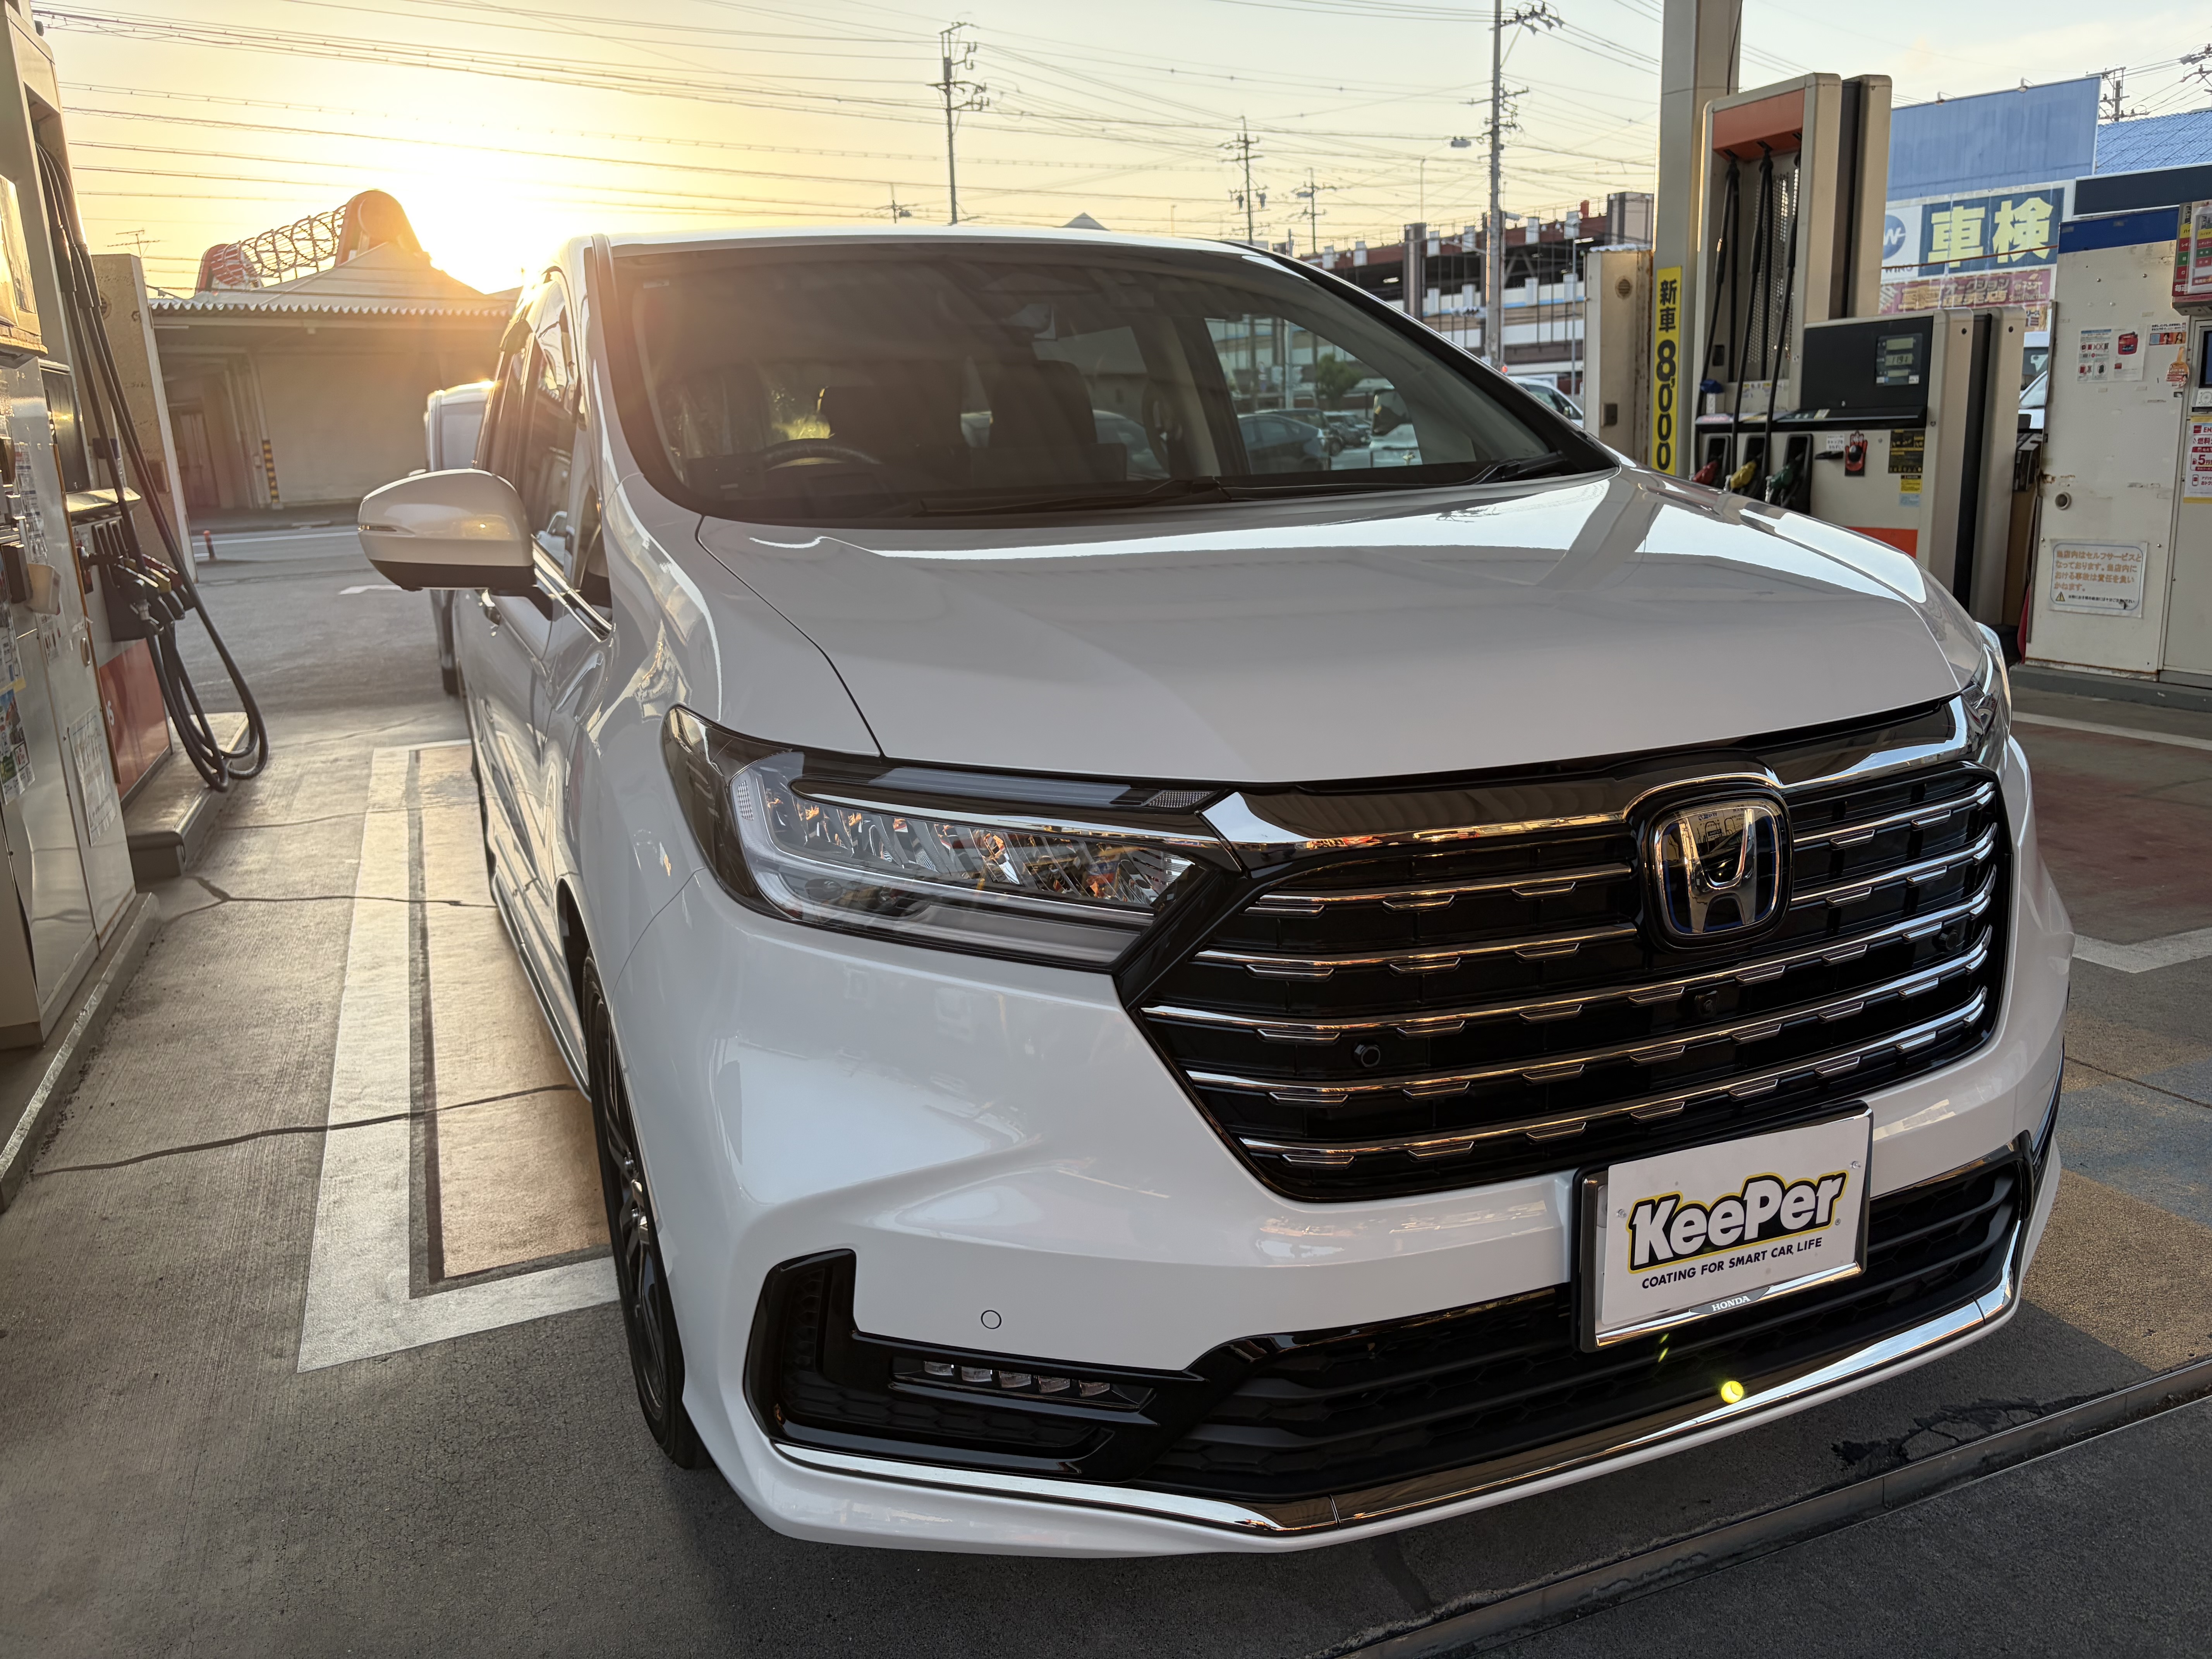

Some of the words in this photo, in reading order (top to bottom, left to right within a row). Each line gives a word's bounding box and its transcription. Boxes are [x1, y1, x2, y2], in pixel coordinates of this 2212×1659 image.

[1927, 197, 2053, 268] 車検
[1659, 278, 1677, 333] 新車
[1656, 340, 1676, 470] 8,000
[2056, 550, 2142, 562] 当店内はセルフサービスと
[1630, 1175, 1844, 1268] KeePer
[1642, 1267, 1696, 1289] COATING
[1701, 1261, 1724, 1275] FOR
[1728, 1249, 1768, 1269] SMART
[1771, 1244, 1793, 1258] CAR
[1797, 1237, 1823, 1252] LIFE
[1712, 1296, 1751, 1312] HONDA
